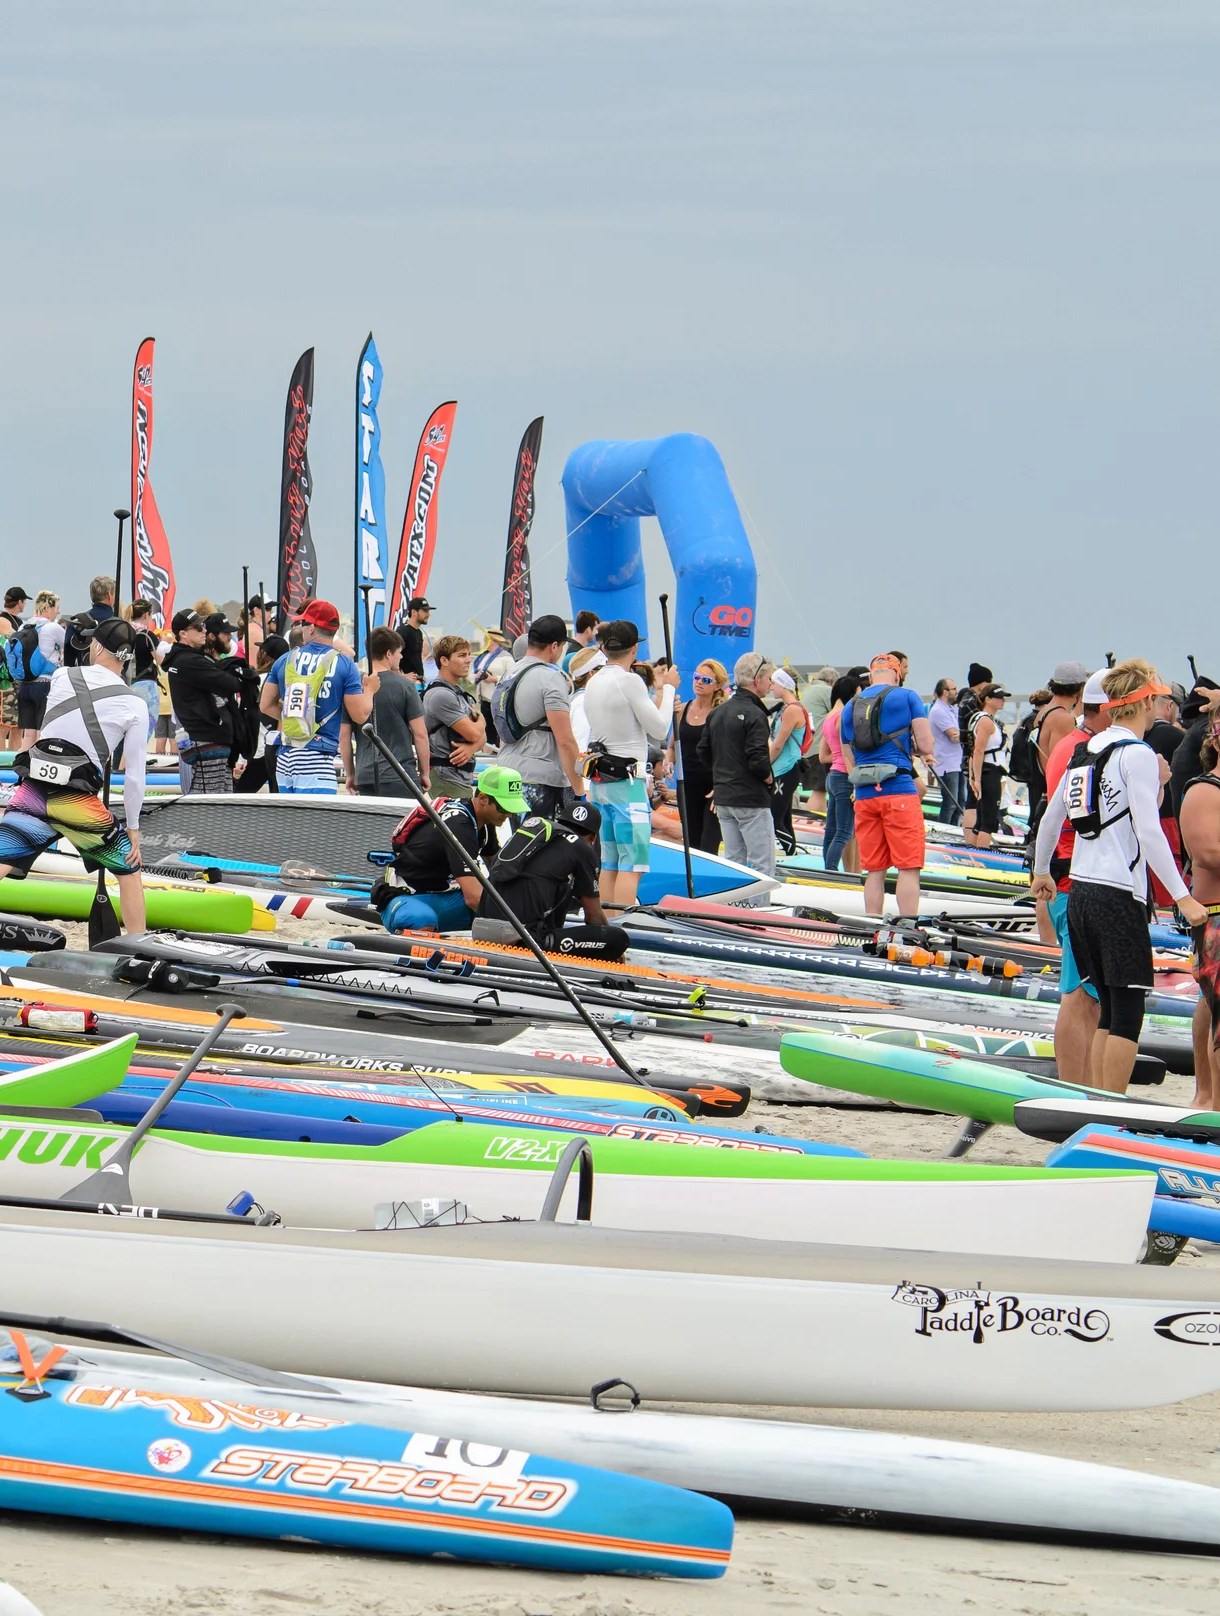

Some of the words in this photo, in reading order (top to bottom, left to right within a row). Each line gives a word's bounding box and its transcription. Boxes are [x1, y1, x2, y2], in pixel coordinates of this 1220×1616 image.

[360, 359, 386, 634] START
[710, 604, 753, 627] GO
[708, 624, 751, 638] TIME!
[289, 689, 303, 710] 590
[38, 764, 59, 780] 59
[574, 940, 607, 950] VIRUS
[858, 958, 921, 975] SIC
[608, 1123, 806, 1155] STARB
[901, 1289, 980, 1306] CAROLINA
[915, 1283, 996, 1343] Paddle
[996, 1296, 1083, 1333] Board
[209, 1449, 567, 1512] STARBOARD
